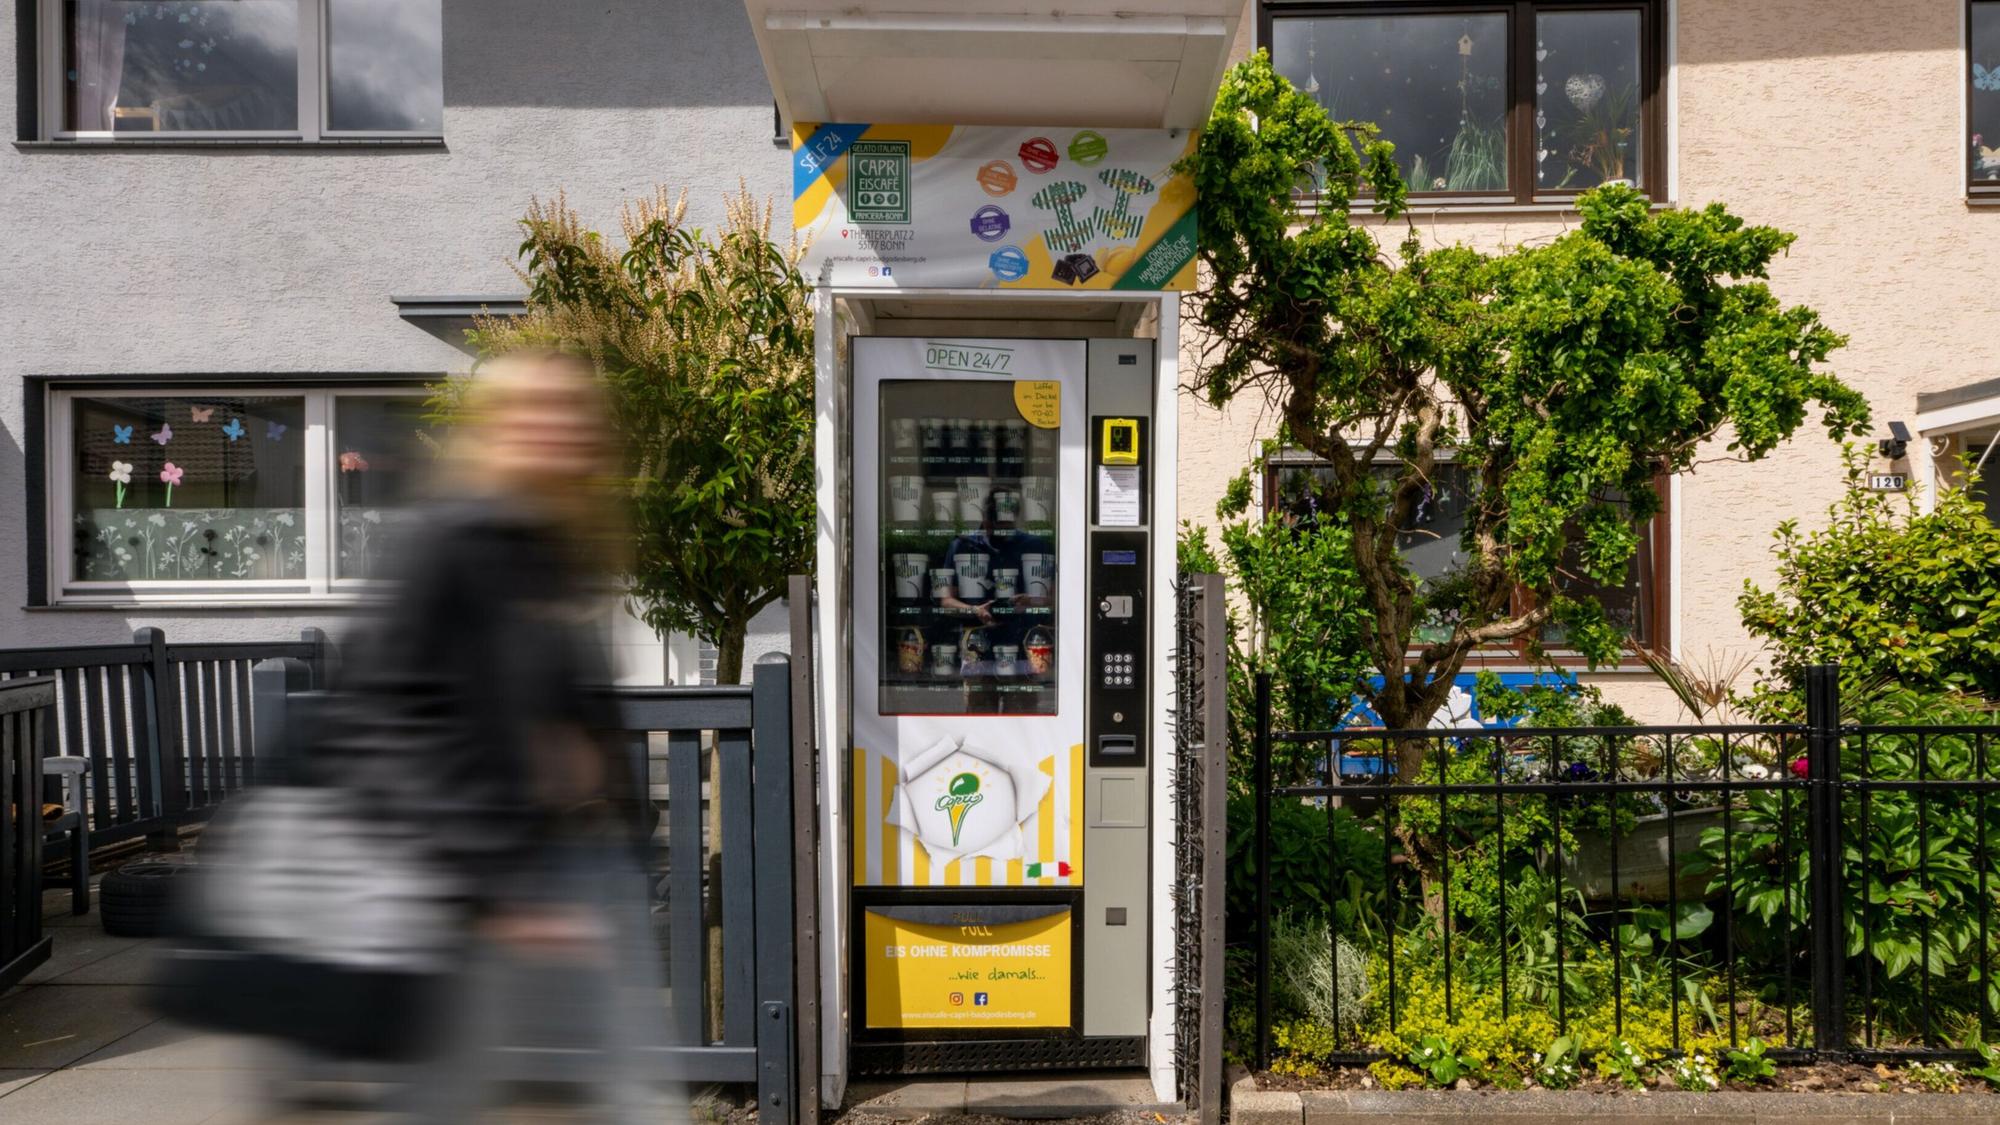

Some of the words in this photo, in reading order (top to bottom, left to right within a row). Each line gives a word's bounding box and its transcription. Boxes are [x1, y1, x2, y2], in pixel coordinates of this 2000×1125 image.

[800, 143, 827, 174] SELF
[824, 131, 842, 151] 24
[852, 144, 876, 153] GELATO
[859, 159, 899, 176] CAPRI
[859, 177, 900, 191] EISCAFÉ
[850, 229, 907, 240] THEATERPLATZ
[908, 230, 915, 240] 2
[880, 240, 905, 251] BONN
[926, 348, 969, 368] OPEN
[972, 352, 1011, 371] 24/7
[1876, 476, 1902, 488] 120
[886, 945, 906, 958] EIS
[910, 945, 948, 958] OHNE
[952, 944, 1051, 958] KOMPROMISSE
